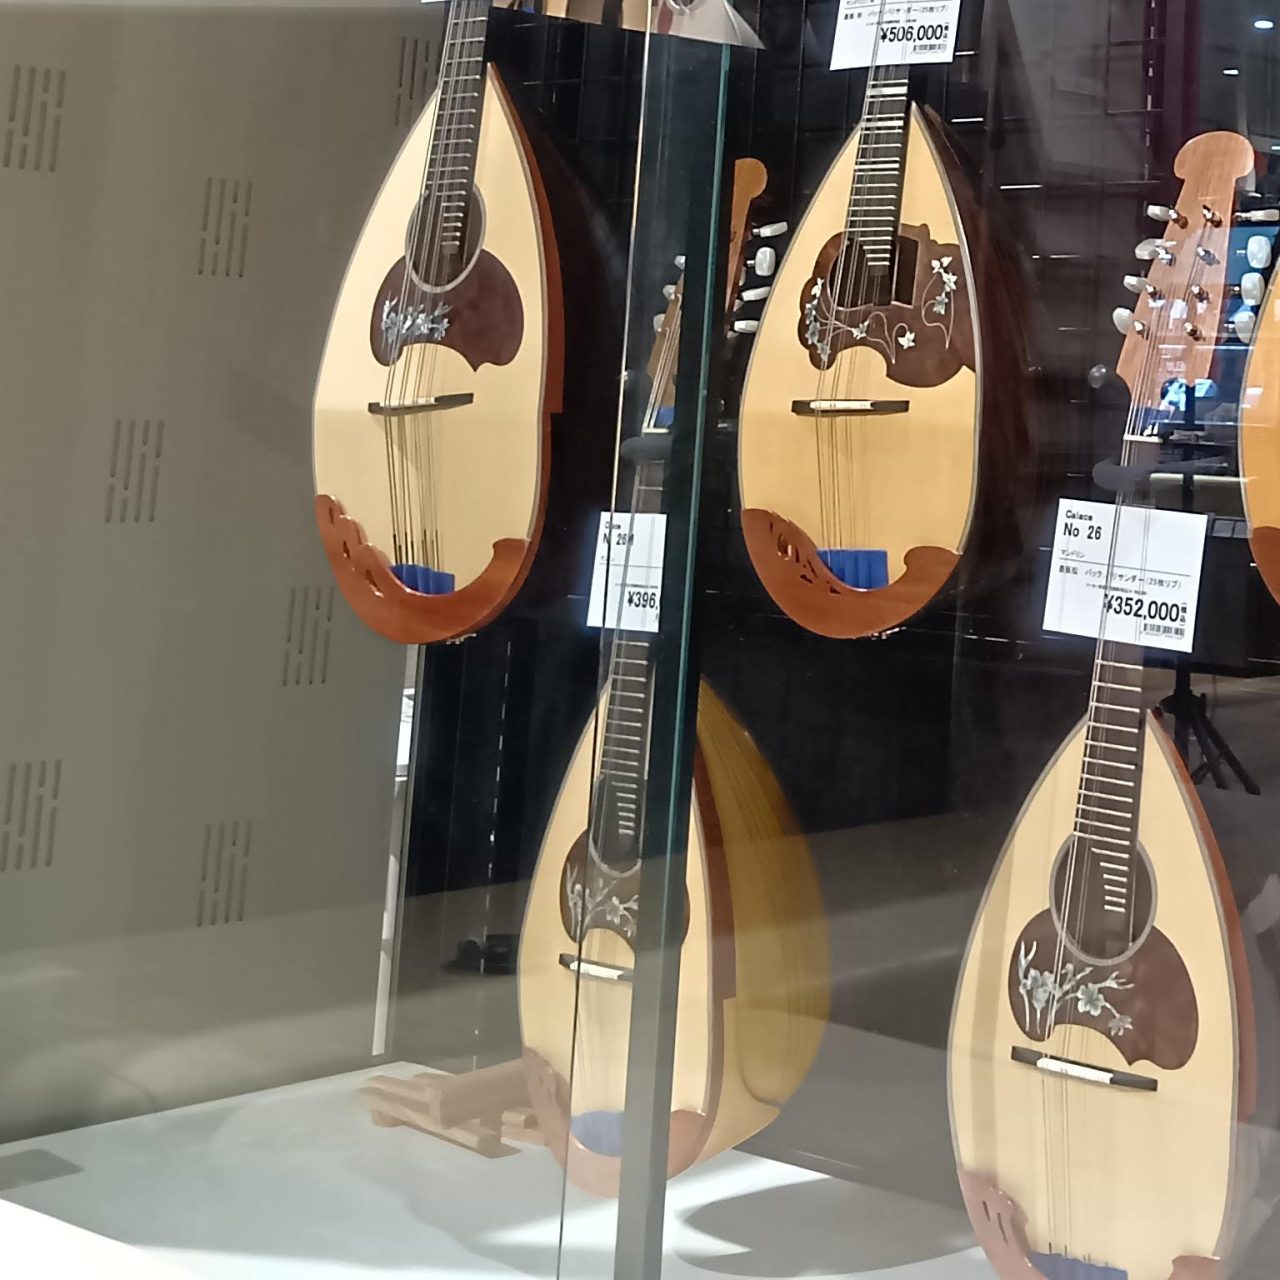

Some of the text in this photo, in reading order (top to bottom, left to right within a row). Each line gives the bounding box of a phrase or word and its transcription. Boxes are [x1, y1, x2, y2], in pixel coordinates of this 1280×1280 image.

[880, 24, 943, 43] ¥506,000
[1065, 509, 1093, 522] Calace
[1063, 522, 1102, 540] No 26
[627, 591, 660, 611] ¥396,
[1103, 593, 1180, 623] ¥352,000
